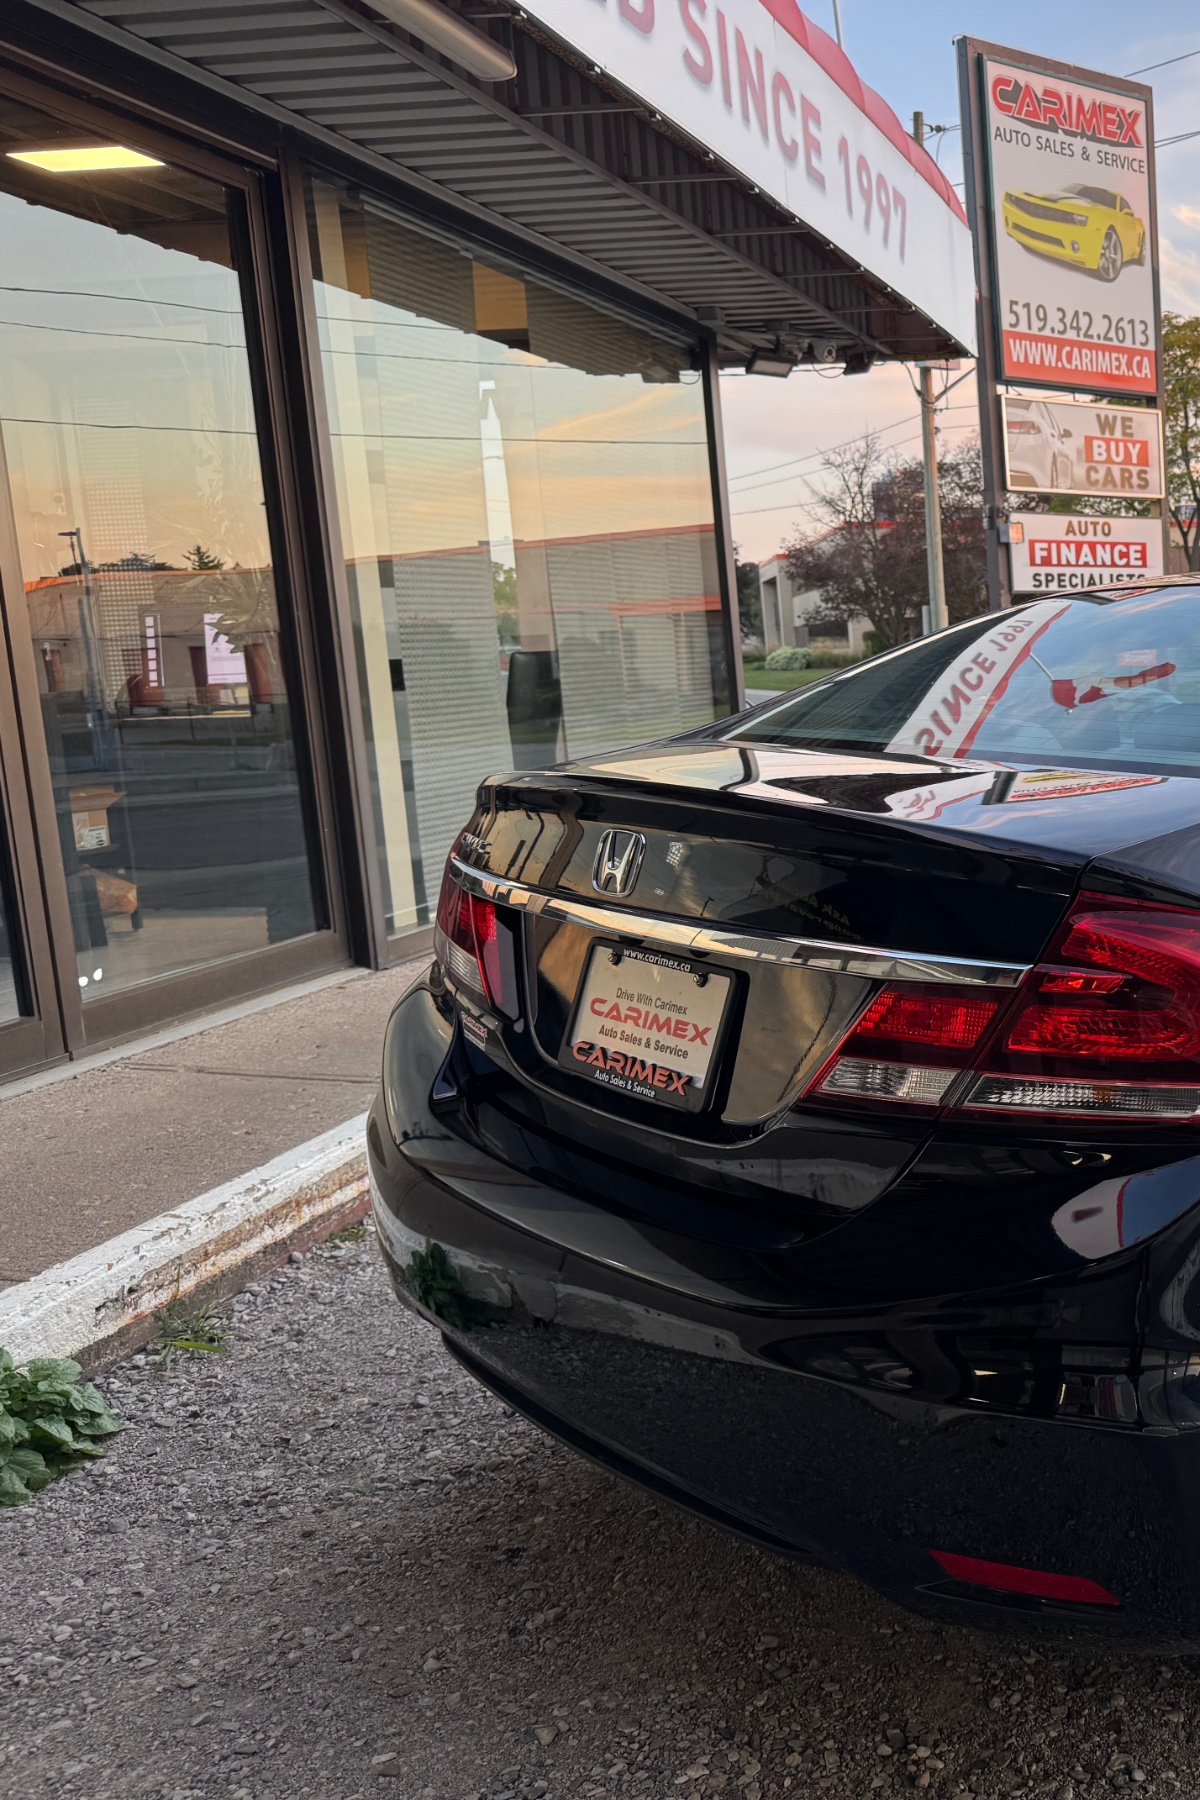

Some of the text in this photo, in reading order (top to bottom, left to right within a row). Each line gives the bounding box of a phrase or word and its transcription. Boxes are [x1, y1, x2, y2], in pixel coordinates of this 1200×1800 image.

[991, 75, 1143, 147] CARIMEX
[680, 0, 907, 262] SINCE 1997
[994, 126, 1145, 174] AUTO SALES & SERVICE
[1008, 300, 1149, 346] 519.342.2613
[1009, 338, 1151, 379] WWW.CARIMEX.CA
[1096, 413, 1134, 438] WE
[1092, 440, 1141, 464] BUY
[1085, 465, 1149, 490] CARS
[1065, 520, 1112, 537] AUTO
[1034, 542, 1143, 566] FINANCE
[623, 948, 691, 972] www.carimex.ca
[616, 987, 688, 1015] Drive With Carimex
[590, 997, 712, 1046] CARIMEX
[599, 1024, 688, 1059] Auto Sales & Service
[572, 1041, 692, 1096] CARIMEX
[594, 1069, 655, 1098] Auto Sales & Service
